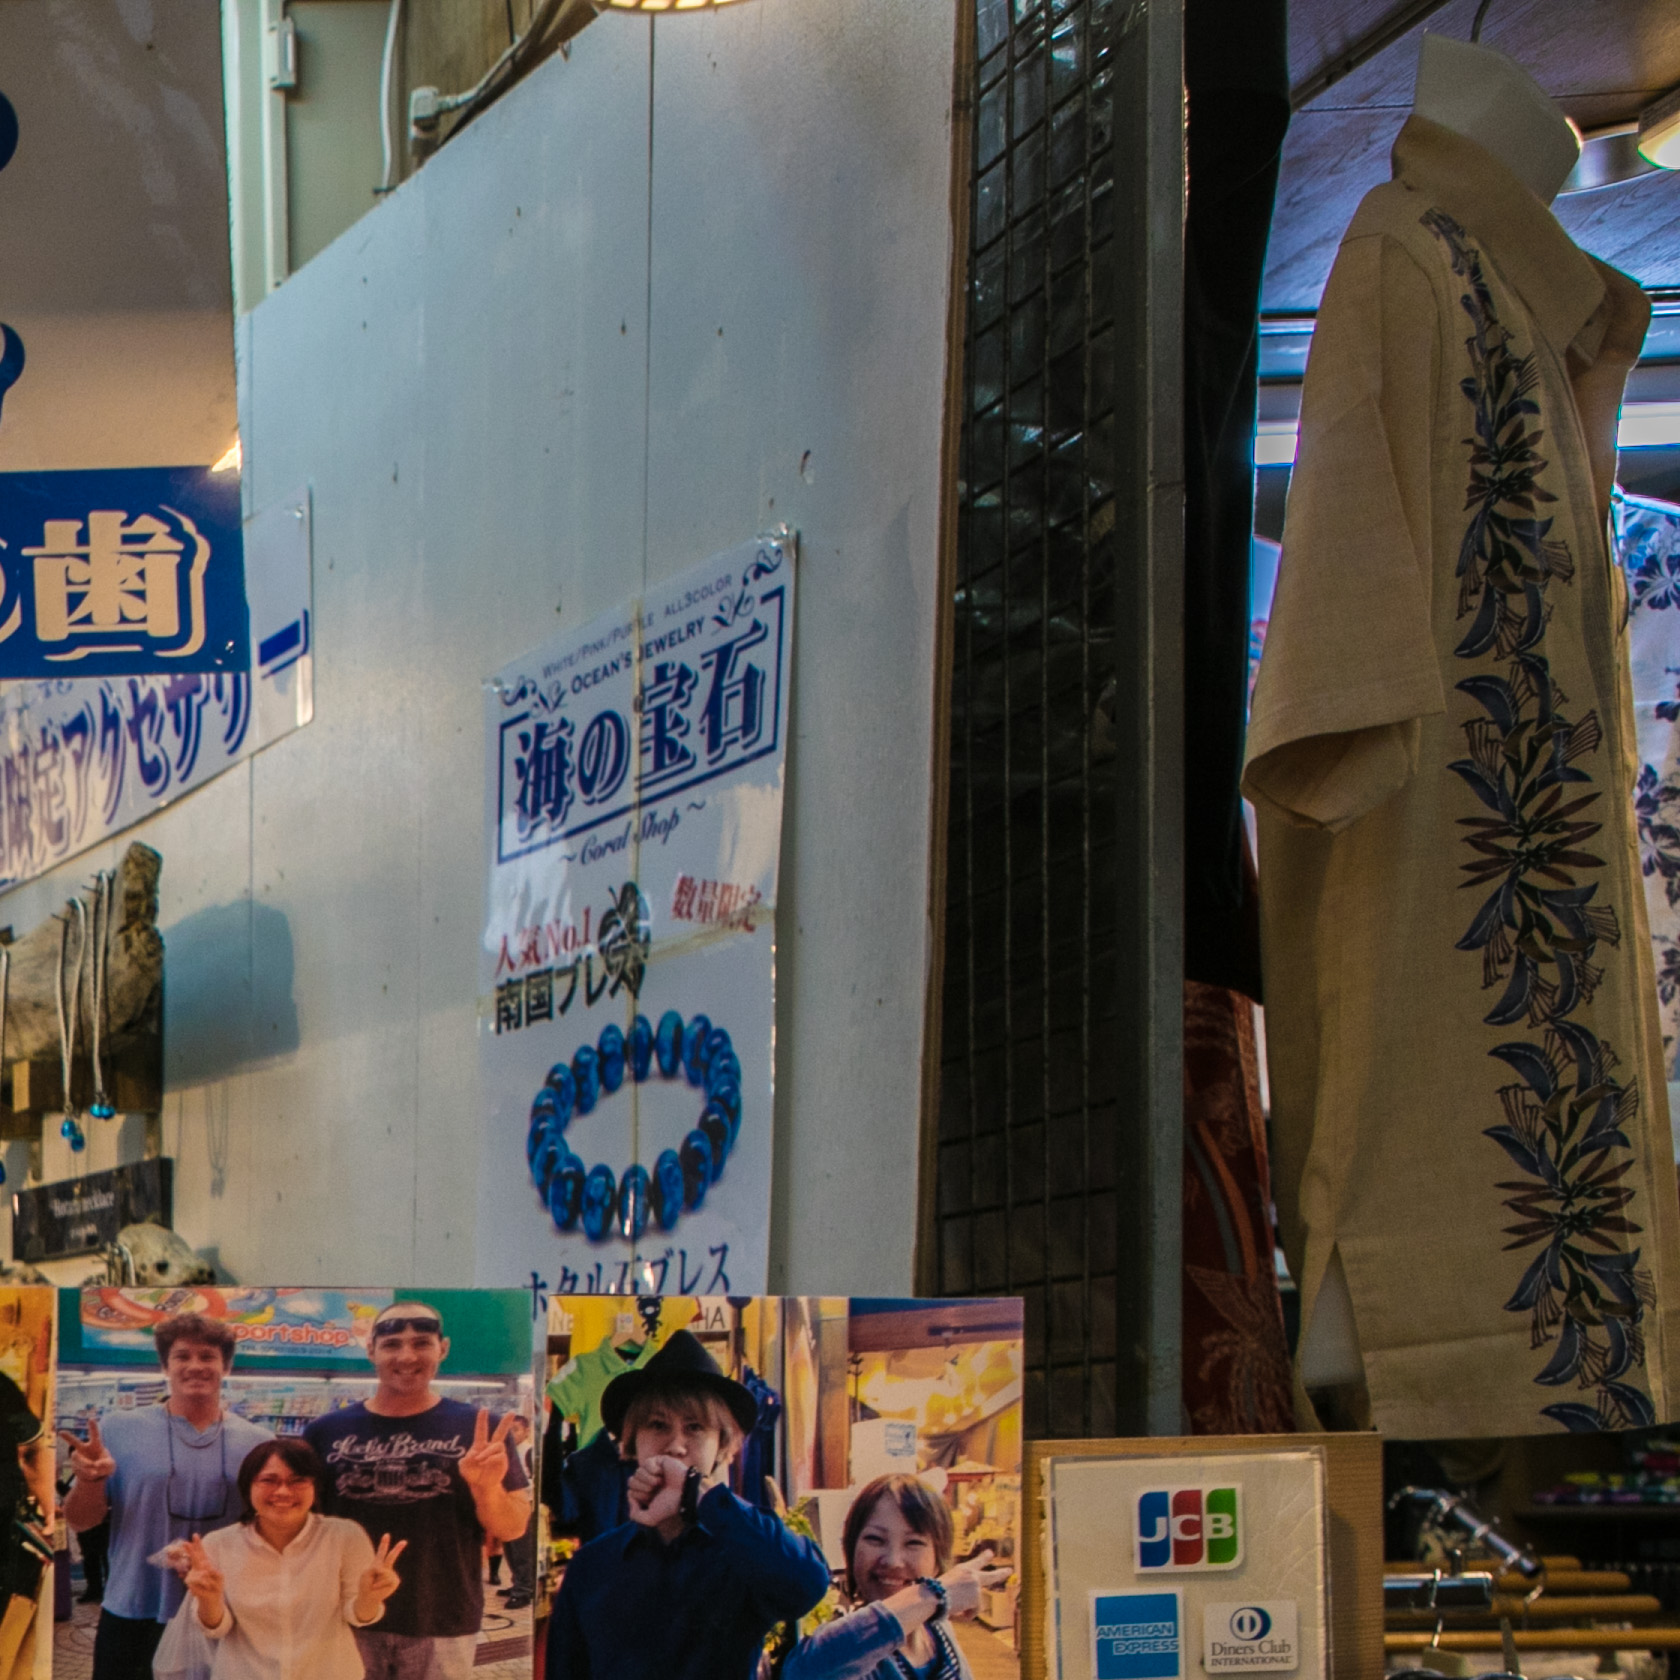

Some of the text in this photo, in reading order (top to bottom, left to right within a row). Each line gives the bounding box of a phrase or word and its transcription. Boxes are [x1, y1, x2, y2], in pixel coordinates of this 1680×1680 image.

[543, 613, 654, 678] WHITE/PINK/PURLE
[571, 650, 633, 695] OCEAN'S
[515, 619, 768, 842] 海の宝石
[581, 822, 632, 864] Coral
[388, 1430, 466, 1458] Brand
[1139, 1513, 1234, 1542] JCB
[1097, 1622, 1174, 1639] AMERICAN
[1114, 1639, 1179, 1655] EXPRESS
[1212, 1640, 1291, 1657] Diners Club
[1212, 1656, 1291, 1666] INTERNATIONAL
